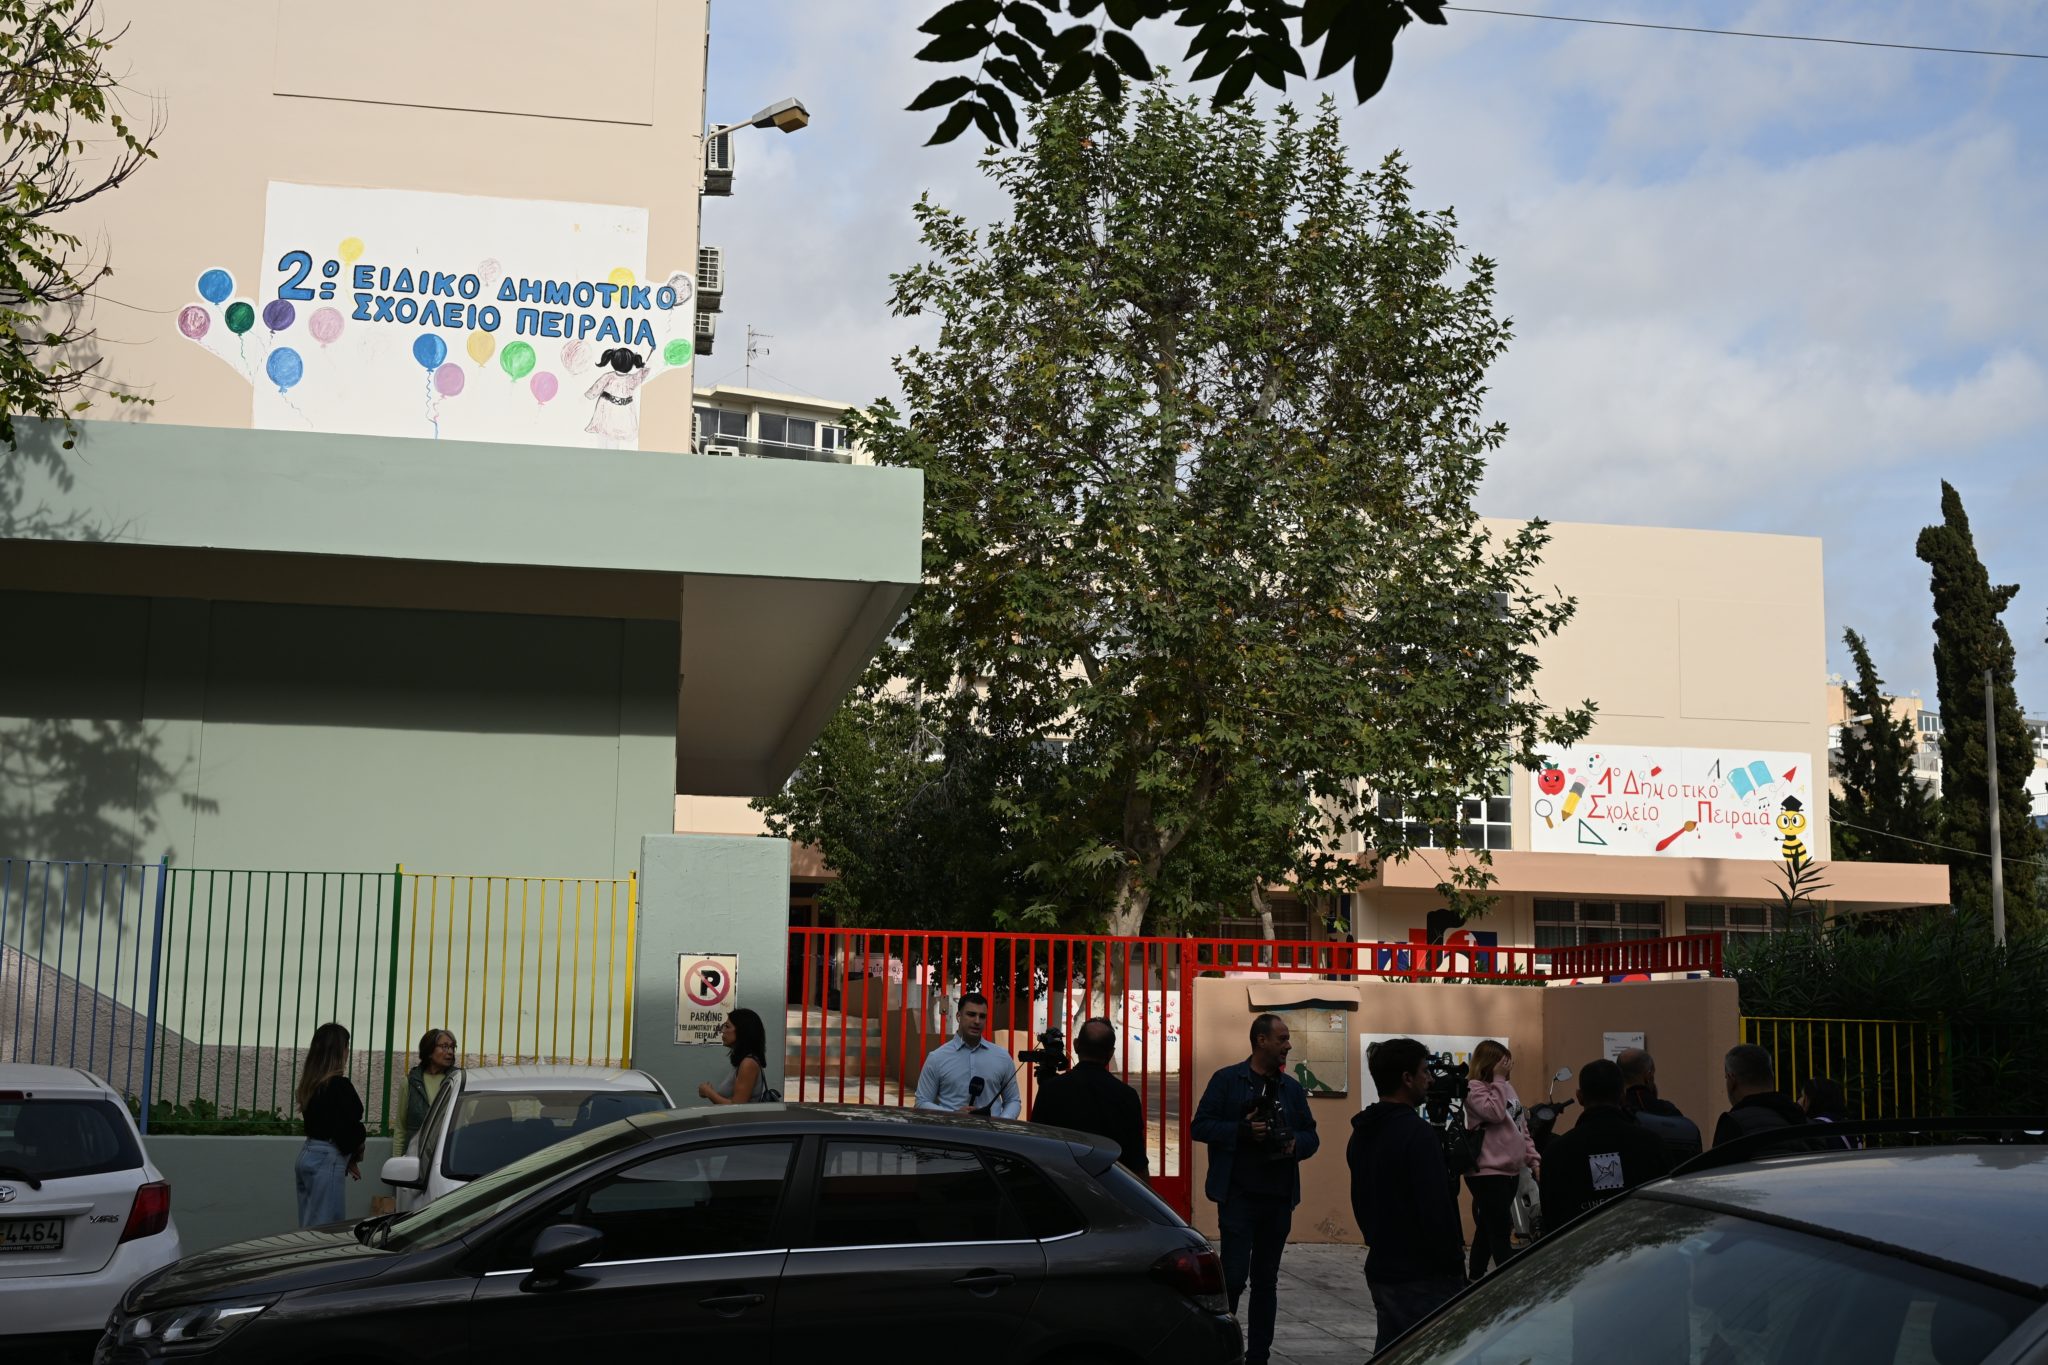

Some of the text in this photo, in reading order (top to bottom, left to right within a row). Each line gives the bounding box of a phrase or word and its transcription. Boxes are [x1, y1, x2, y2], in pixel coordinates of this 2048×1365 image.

[353, 264, 480, 300] ΕΙΔΙΚΟ
[497, 276, 676, 311] ΔΗΜΟΤΙΚΟ
[352, 292, 656, 350] ΣΧΟΛΕΙΟ ΠΕΙΡΑΙΑ
[1623, 769, 1719, 800] Δημοτικό
[1587, 794, 1771, 829] Σχολείο Πειραιά
[690, 1012, 723, 1022] PARKING
[89, 1214, 120, 1224] YARIS
